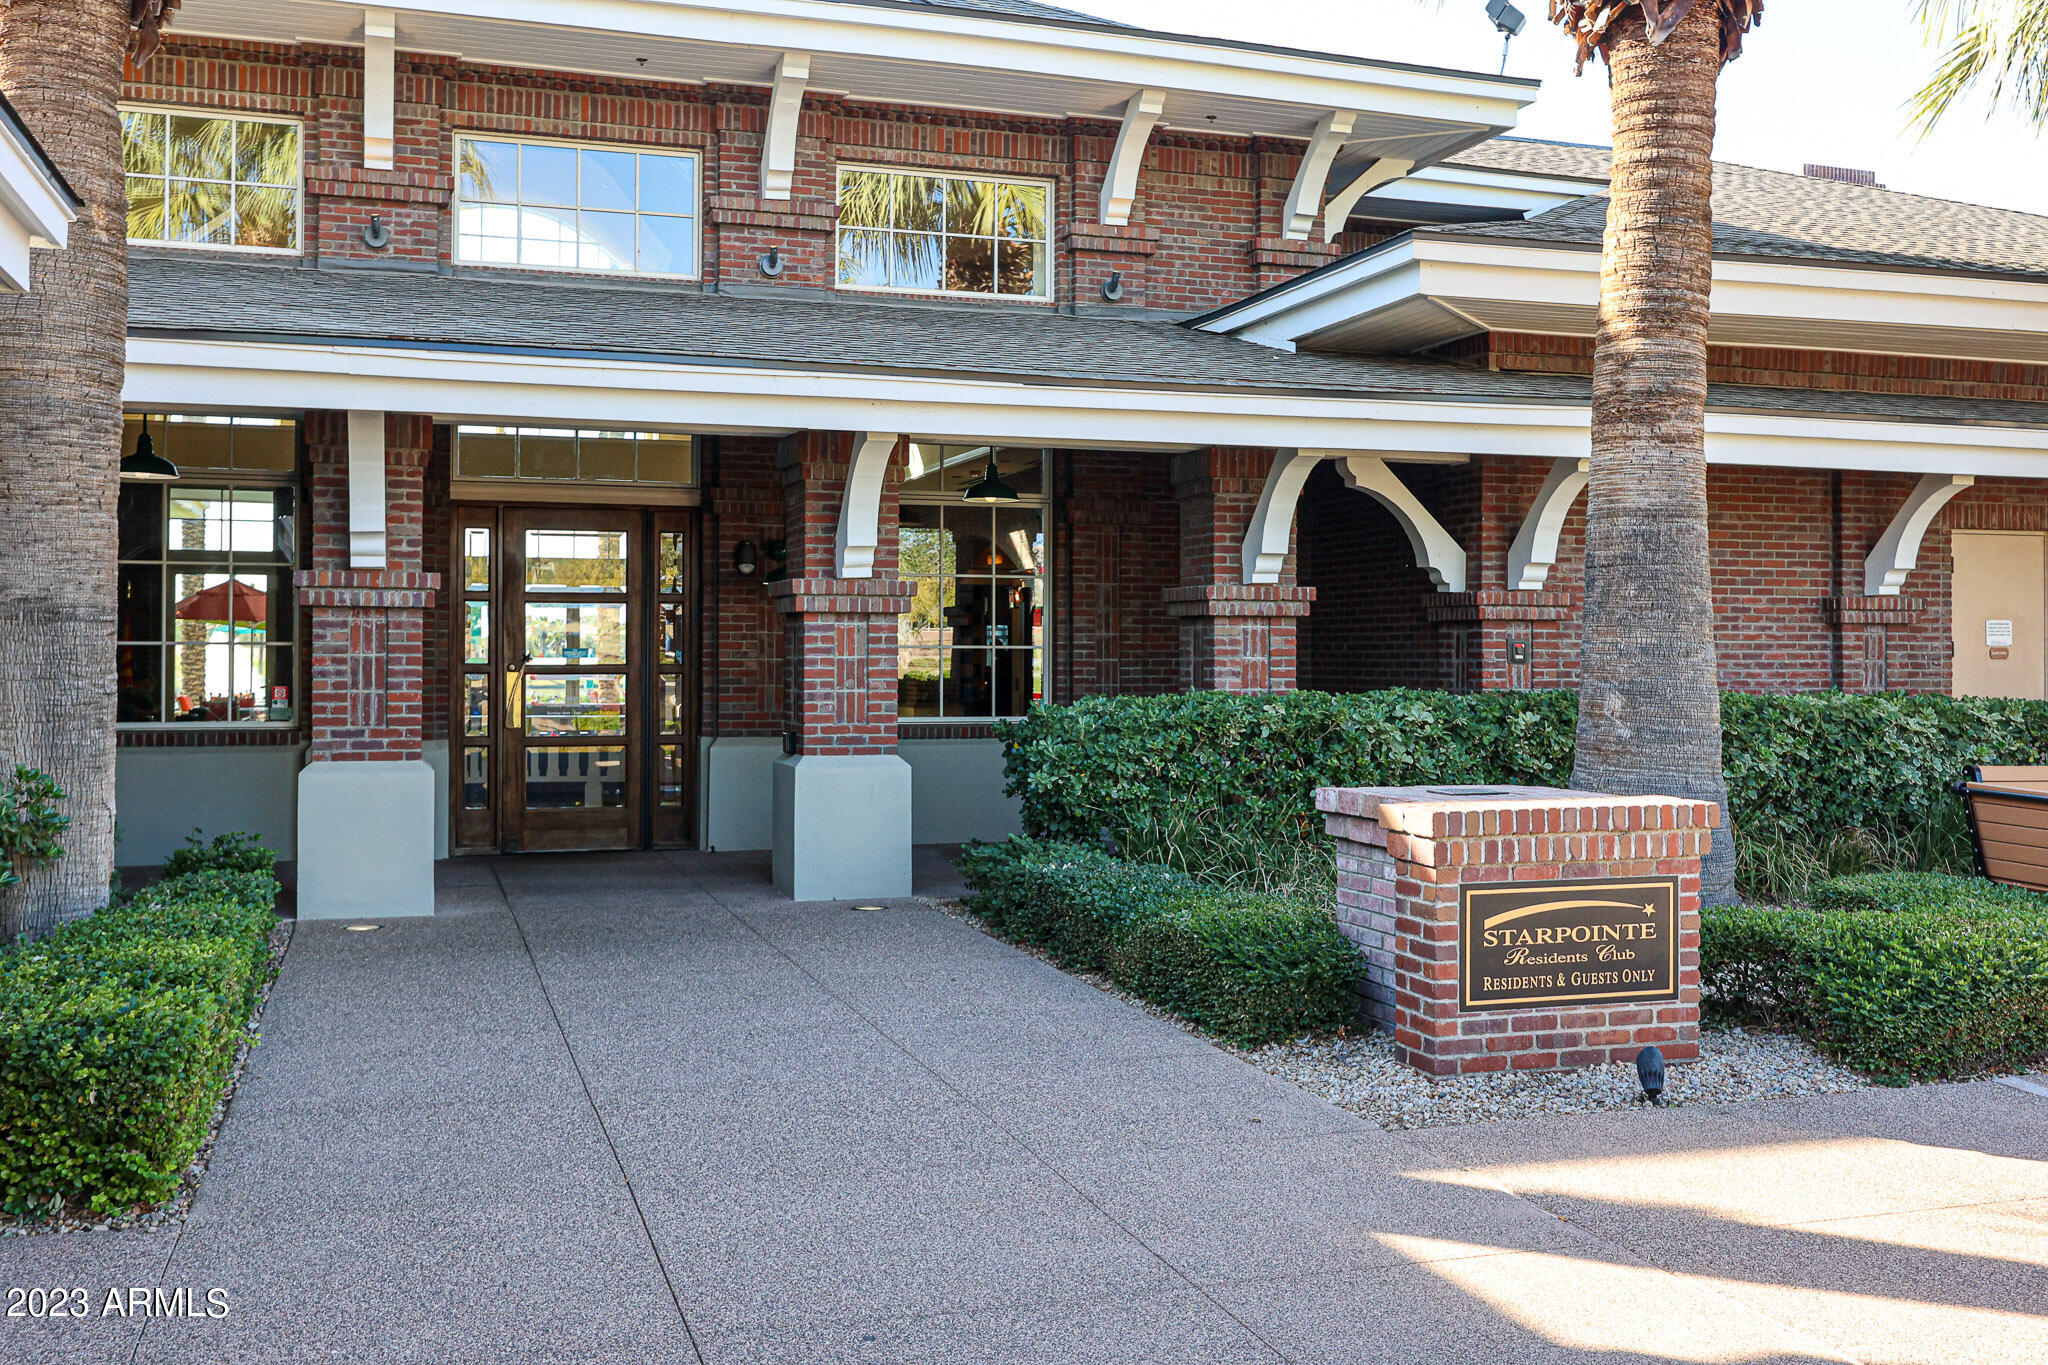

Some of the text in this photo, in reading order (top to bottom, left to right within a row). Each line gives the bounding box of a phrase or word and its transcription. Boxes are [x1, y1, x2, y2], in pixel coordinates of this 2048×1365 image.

[1483, 922, 1657, 948] STARPOINTE
[1503, 944, 1636, 965] Residents Club
[1483, 968, 1656, 991] RESIDENTS & GUESTS ONLY
